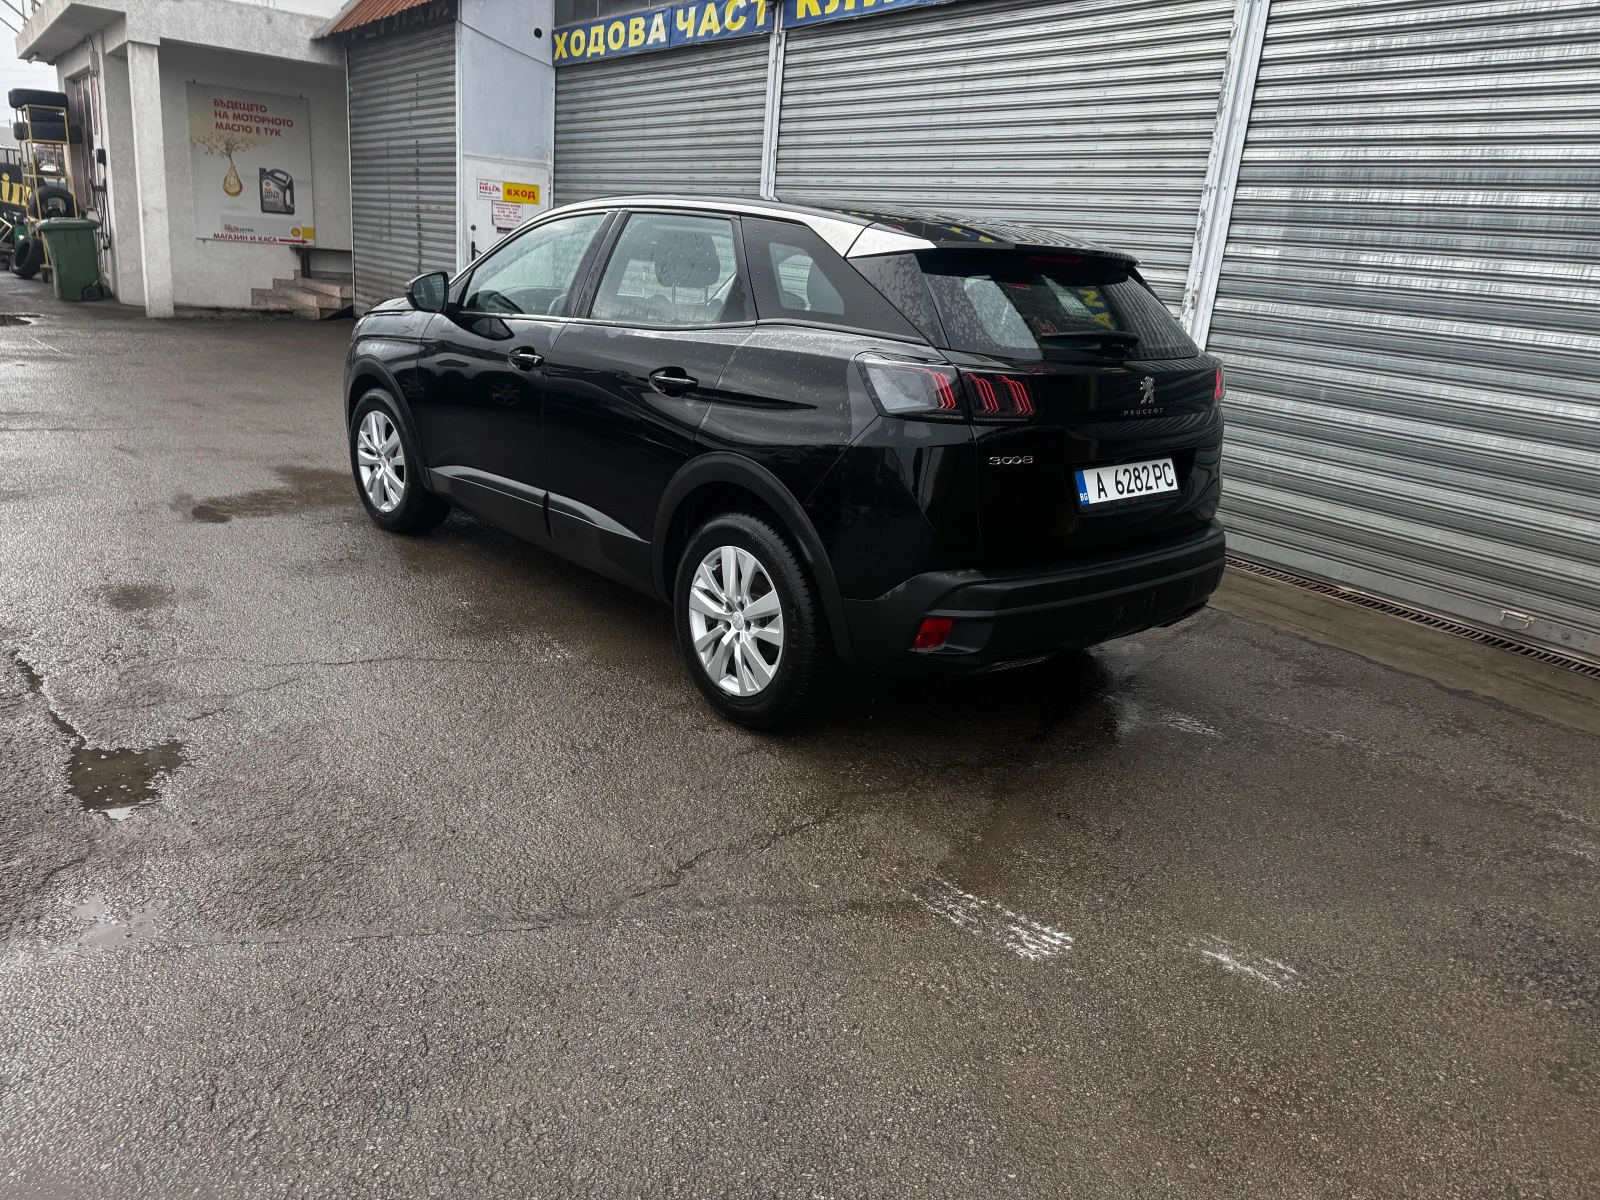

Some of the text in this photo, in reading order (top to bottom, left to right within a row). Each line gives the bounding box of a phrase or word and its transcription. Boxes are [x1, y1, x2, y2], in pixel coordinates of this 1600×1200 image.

[554, 13, 667, 61] ХОДОВА
[676, 0, 767, 39] ЧАСТ
[213, 98, 268, 113] БЪДЕЩЕТО
[214, 110, 294, 128] НА МОТОРНОТО
[215, 121, 282, 137] МАСЛО Е ТУК
[506, 188, 536, 200] ВХОД
[213, 232, 248, 241] МАГАЗИН
[257, 235, 278, 243] КАСА
[1123, 407, 1164, 416] PEUGEOT
[988, 455, 1034, 465] 3008
[1096, 472, 1108, 499] A
[1080, 492, 1089, 502] BG
